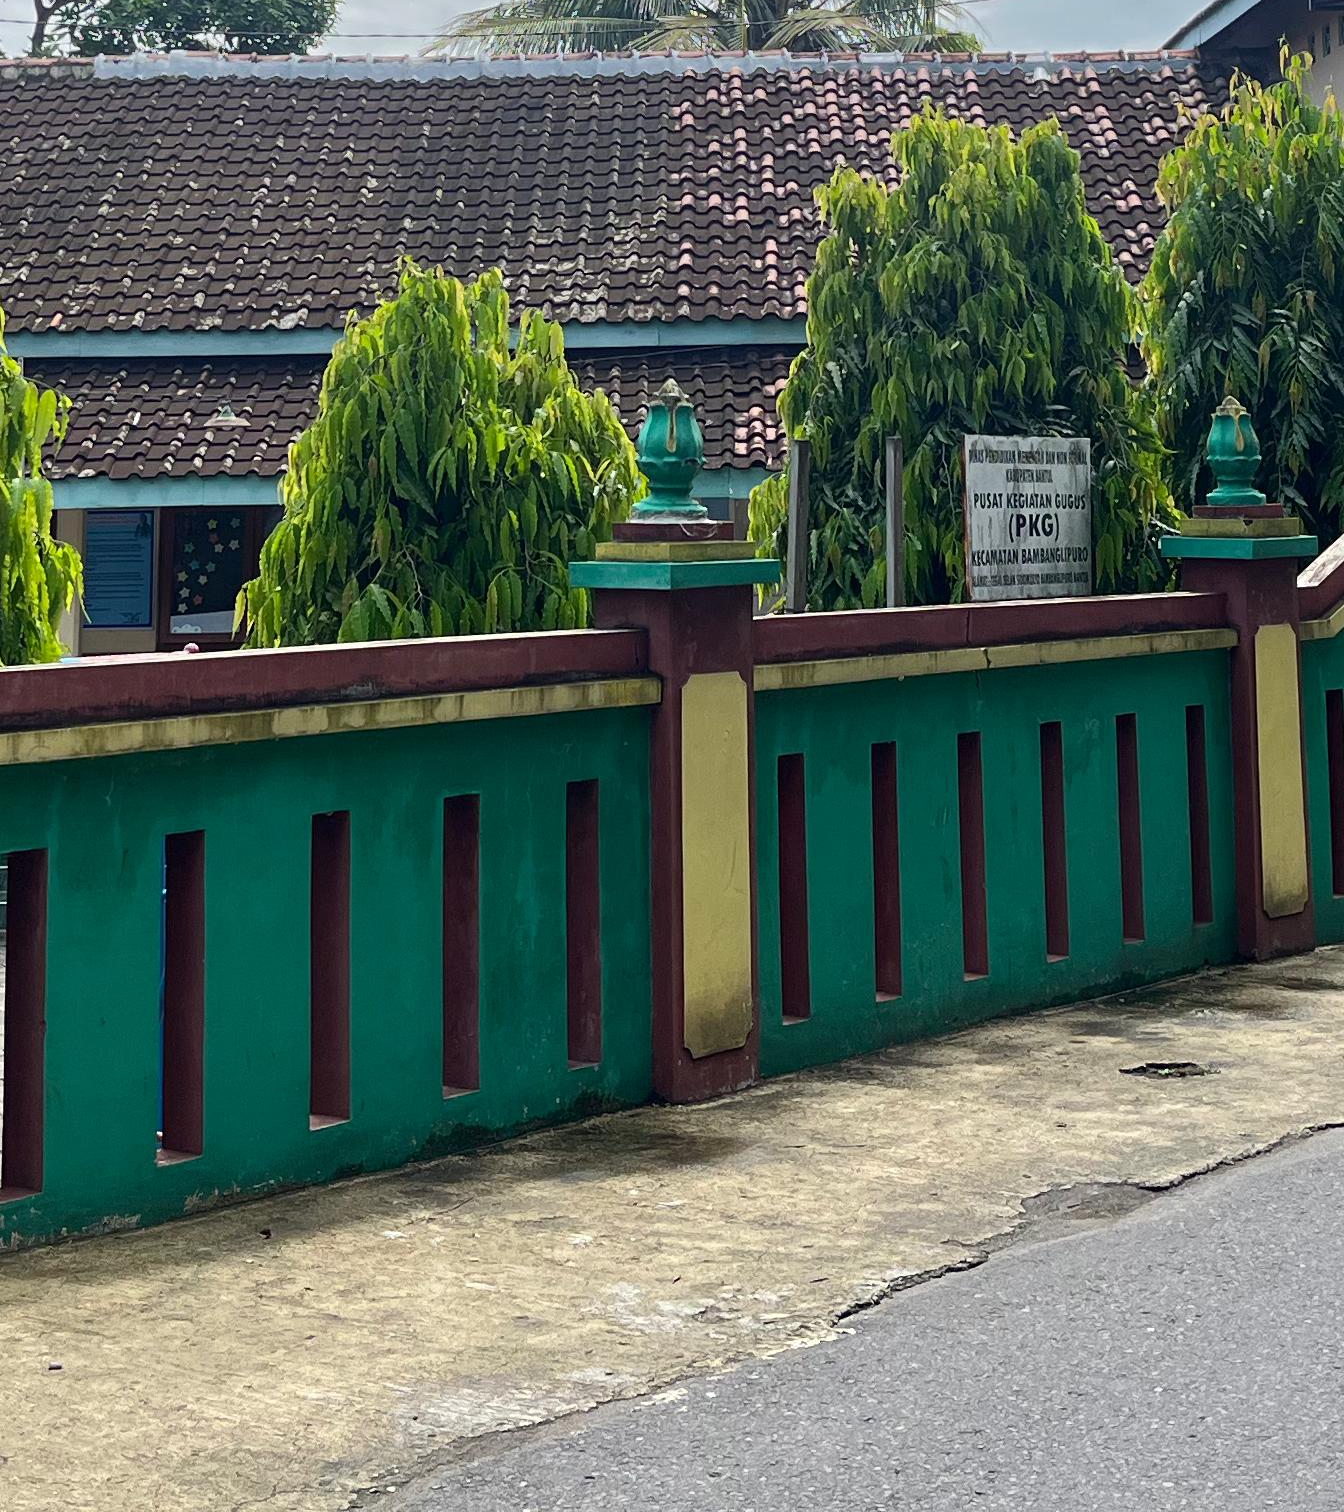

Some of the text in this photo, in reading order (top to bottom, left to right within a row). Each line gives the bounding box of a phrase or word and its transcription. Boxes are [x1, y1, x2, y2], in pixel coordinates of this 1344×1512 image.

[973, 492, 1087, 511] PUSAT KEGIATAN GUGUS
[1008, 513, 1060, 544] (PKG)
[971, 546, 1089, 567] KECAMATAN BAMBANGLIPURO
